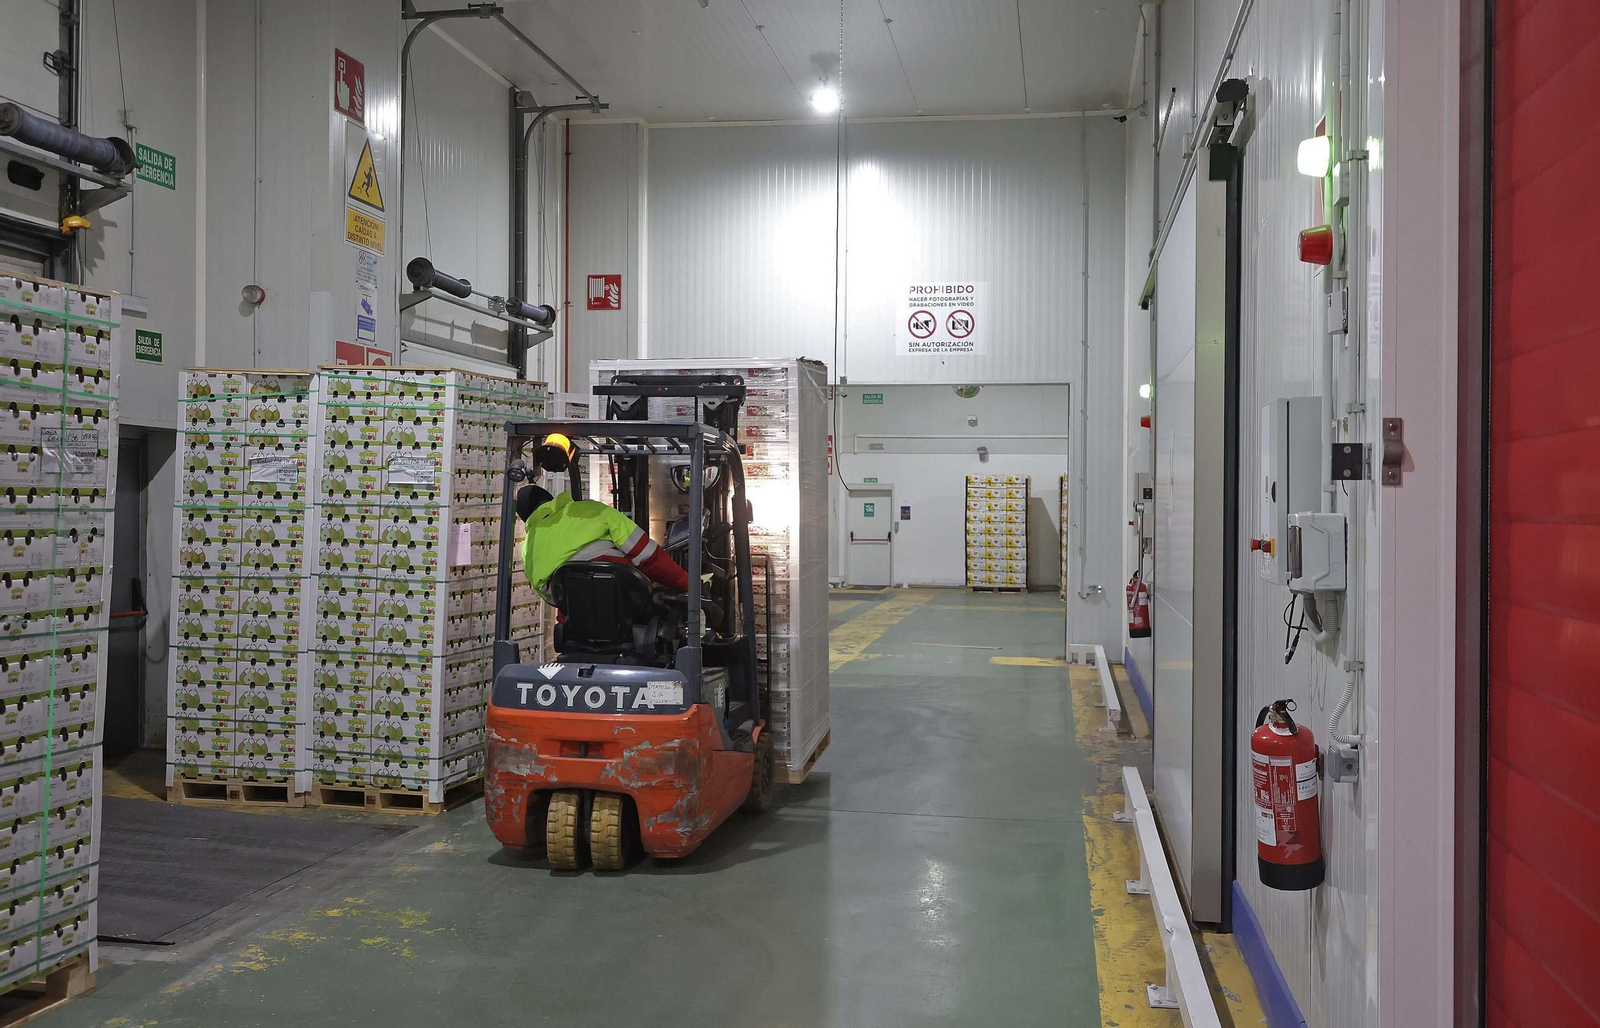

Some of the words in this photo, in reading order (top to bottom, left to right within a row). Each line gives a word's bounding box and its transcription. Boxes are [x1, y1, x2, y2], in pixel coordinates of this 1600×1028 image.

[138, 147, 163, 168] SALIDA
[164, 156, 173, 171] DE
[137, 162, 174, 187] EMERGENCIA
[347, 231, 370, 246] DISTINTO
[909, 285, 975, 294] PROHIBIDO
[138, 335, 152, 345] SALIDA
[154, 338, 160, 347] DE
[516, 682, 655, 711] TOYOTA
